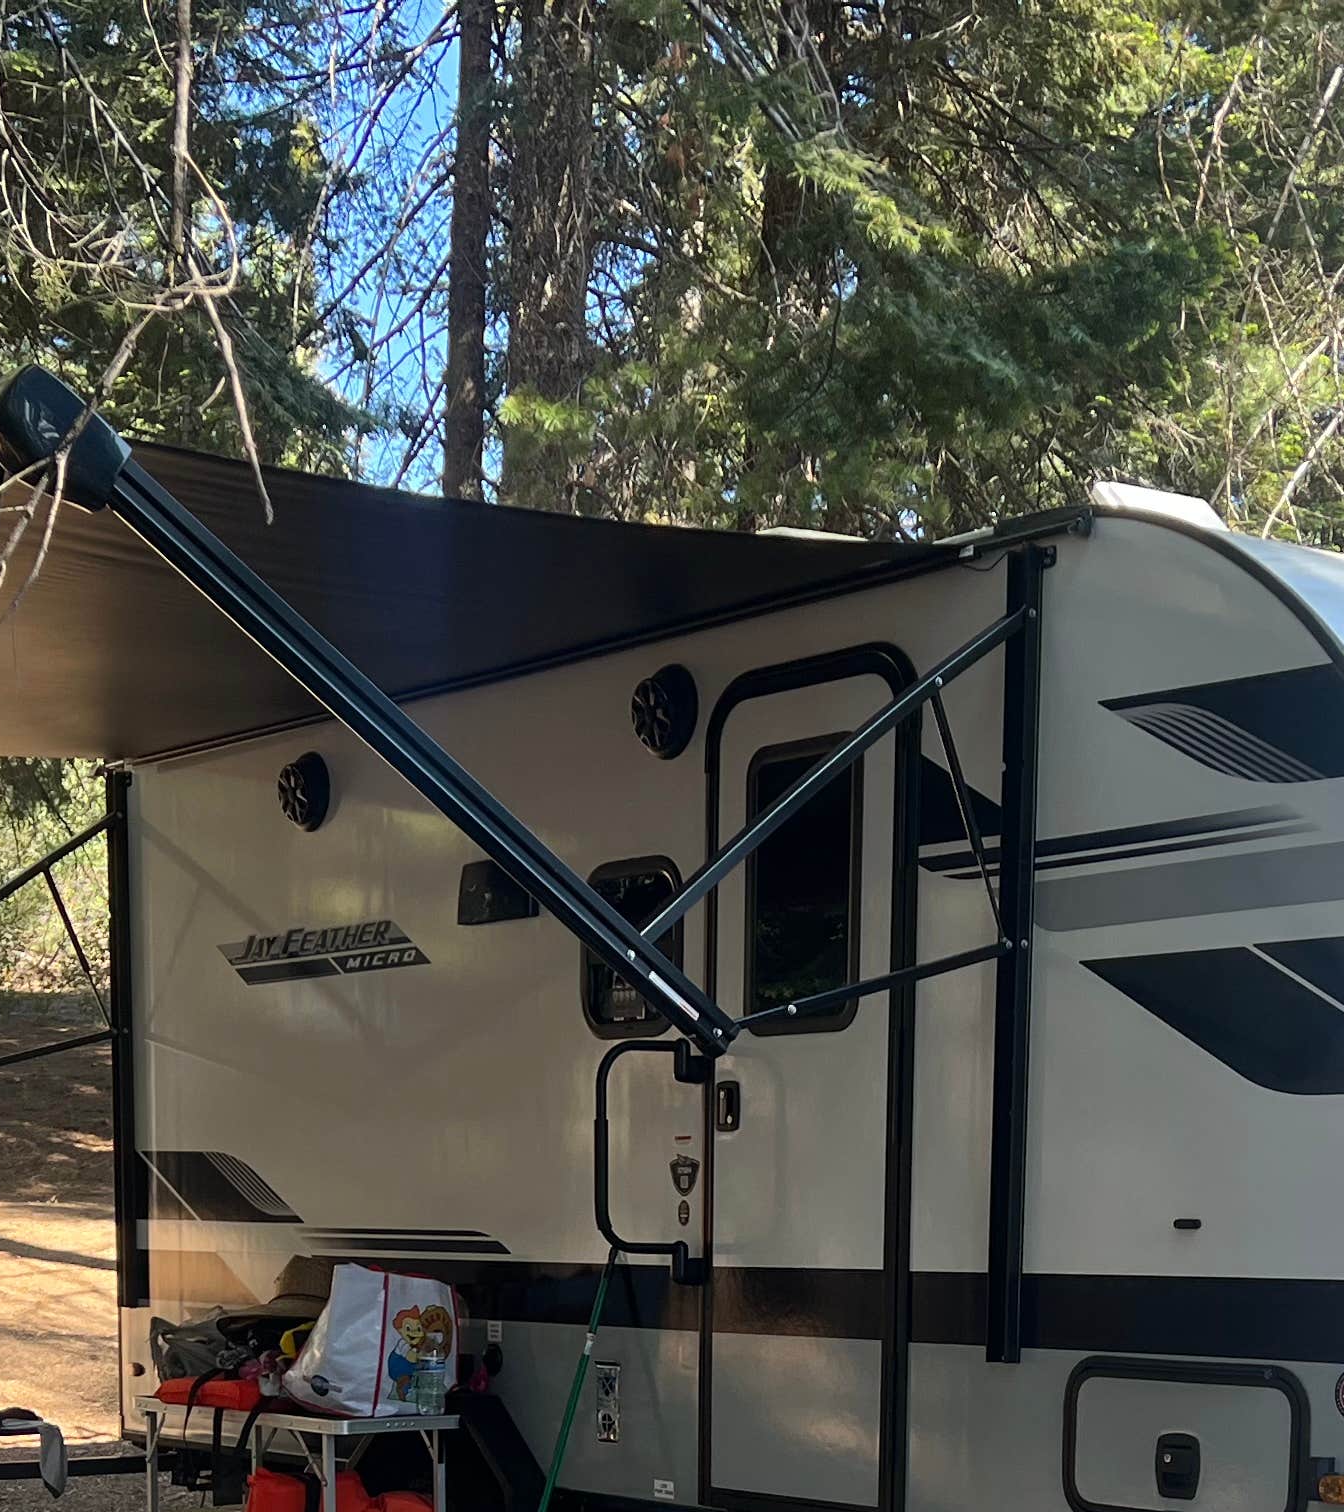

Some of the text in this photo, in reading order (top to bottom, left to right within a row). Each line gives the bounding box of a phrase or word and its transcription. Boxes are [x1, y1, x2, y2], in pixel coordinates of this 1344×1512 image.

[232, 919, 392, 962] JAY FEATHER
[345, 949, 417, 970] MICRO
